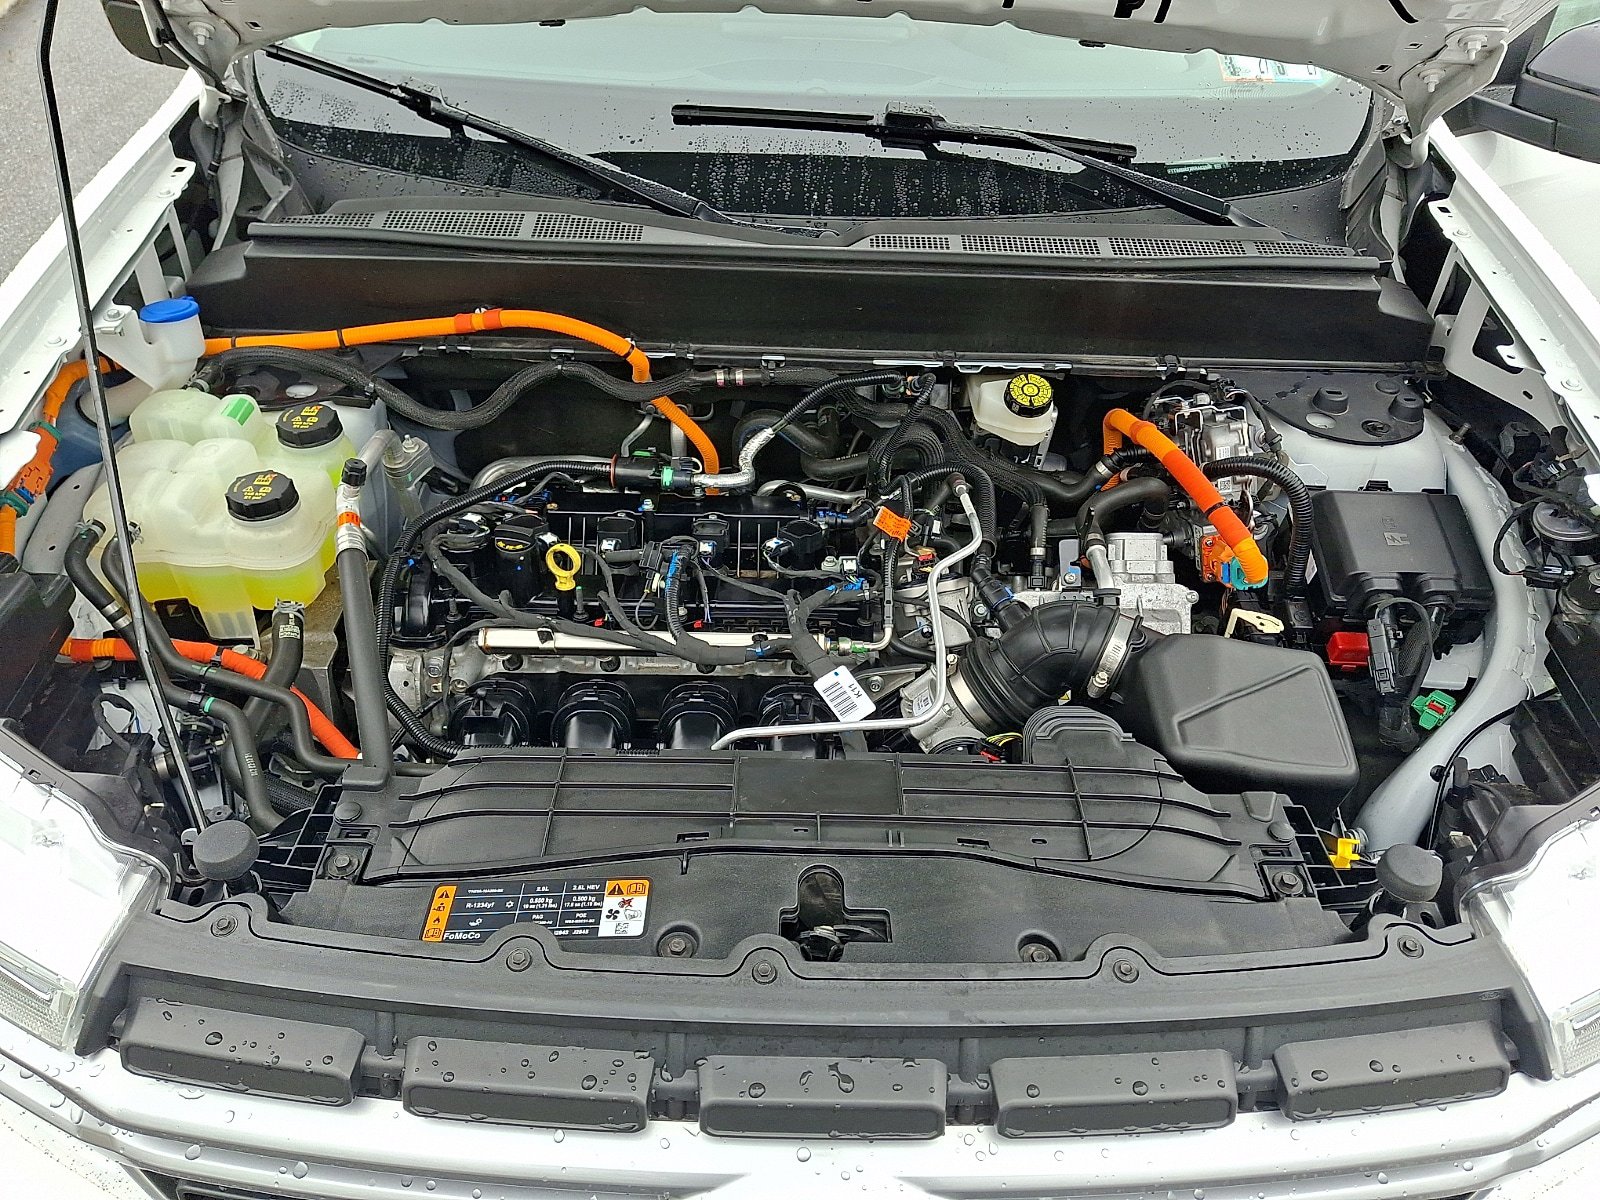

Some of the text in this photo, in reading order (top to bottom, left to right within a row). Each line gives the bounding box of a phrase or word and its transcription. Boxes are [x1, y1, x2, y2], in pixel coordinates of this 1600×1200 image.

[848, 683, 863, 699] K11
[465, 902, 495, 910] R-1234yf
[443, 932, 481, 940] FoMoCo
